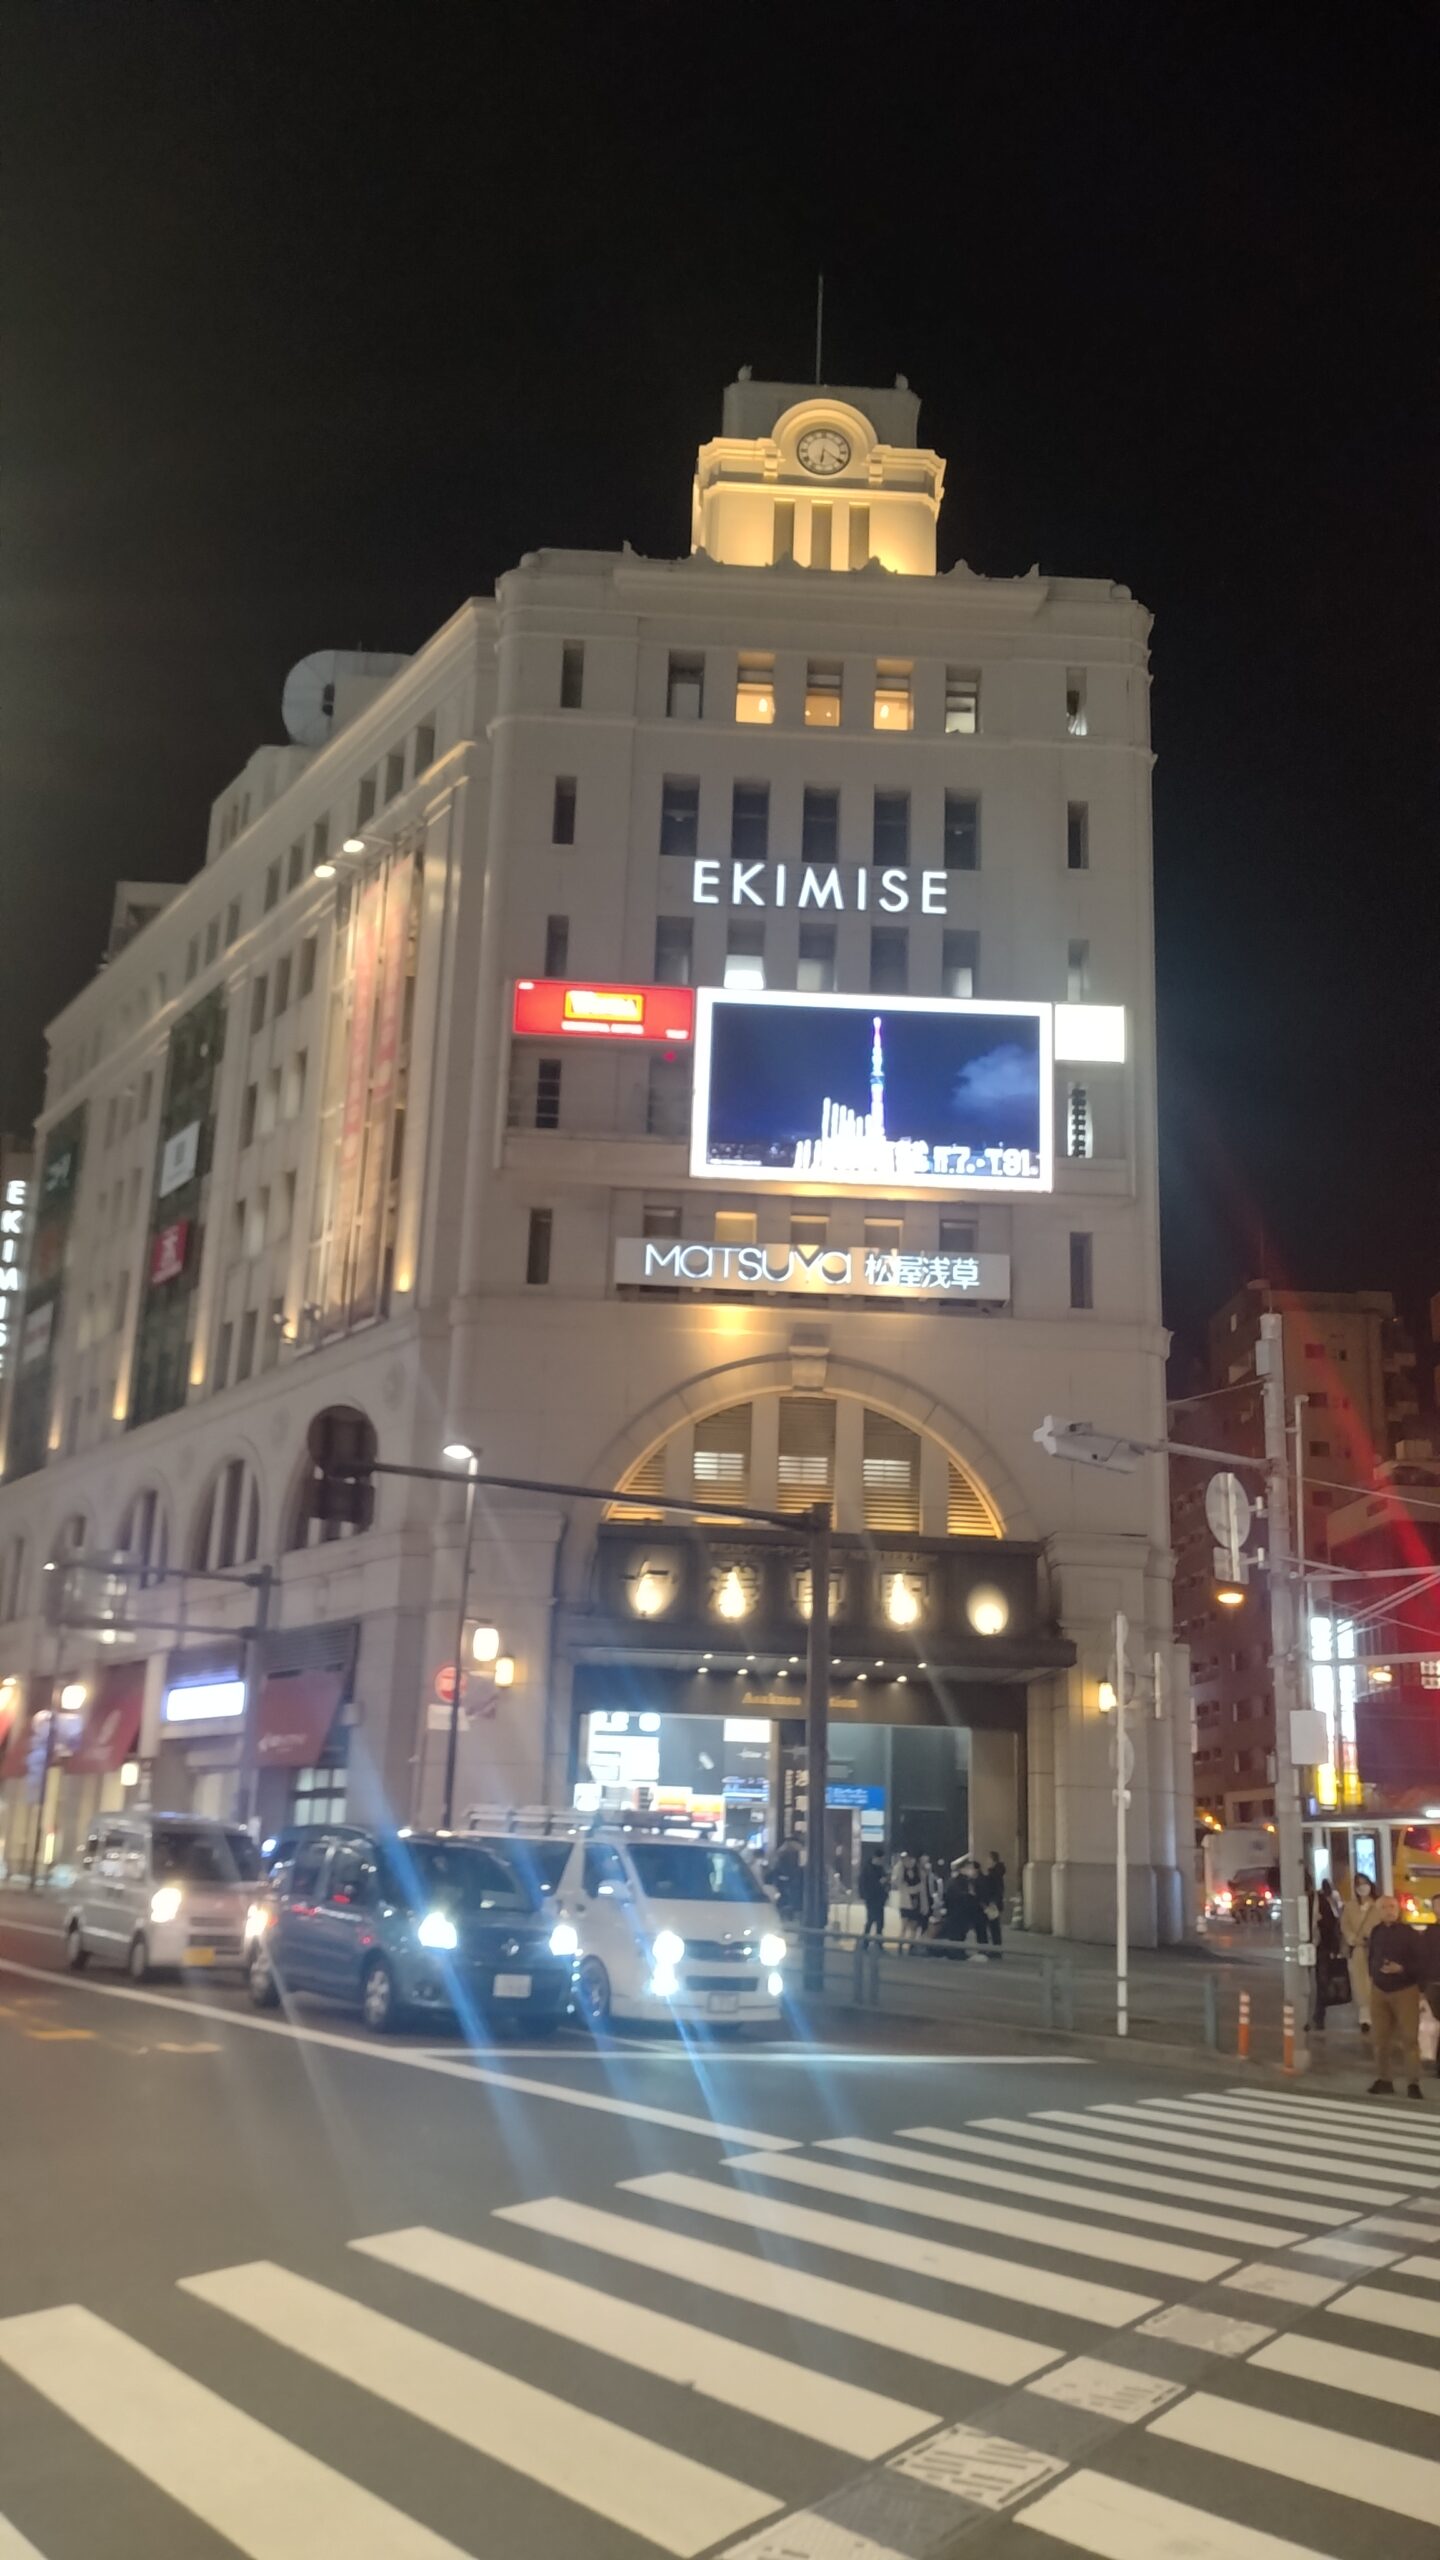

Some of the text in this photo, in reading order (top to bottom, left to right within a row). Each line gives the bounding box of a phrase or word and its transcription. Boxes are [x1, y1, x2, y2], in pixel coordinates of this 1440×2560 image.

[692, 859, 948, 914] EKIMISE
[865, 1253, 980, 1289] 松屋浅草
